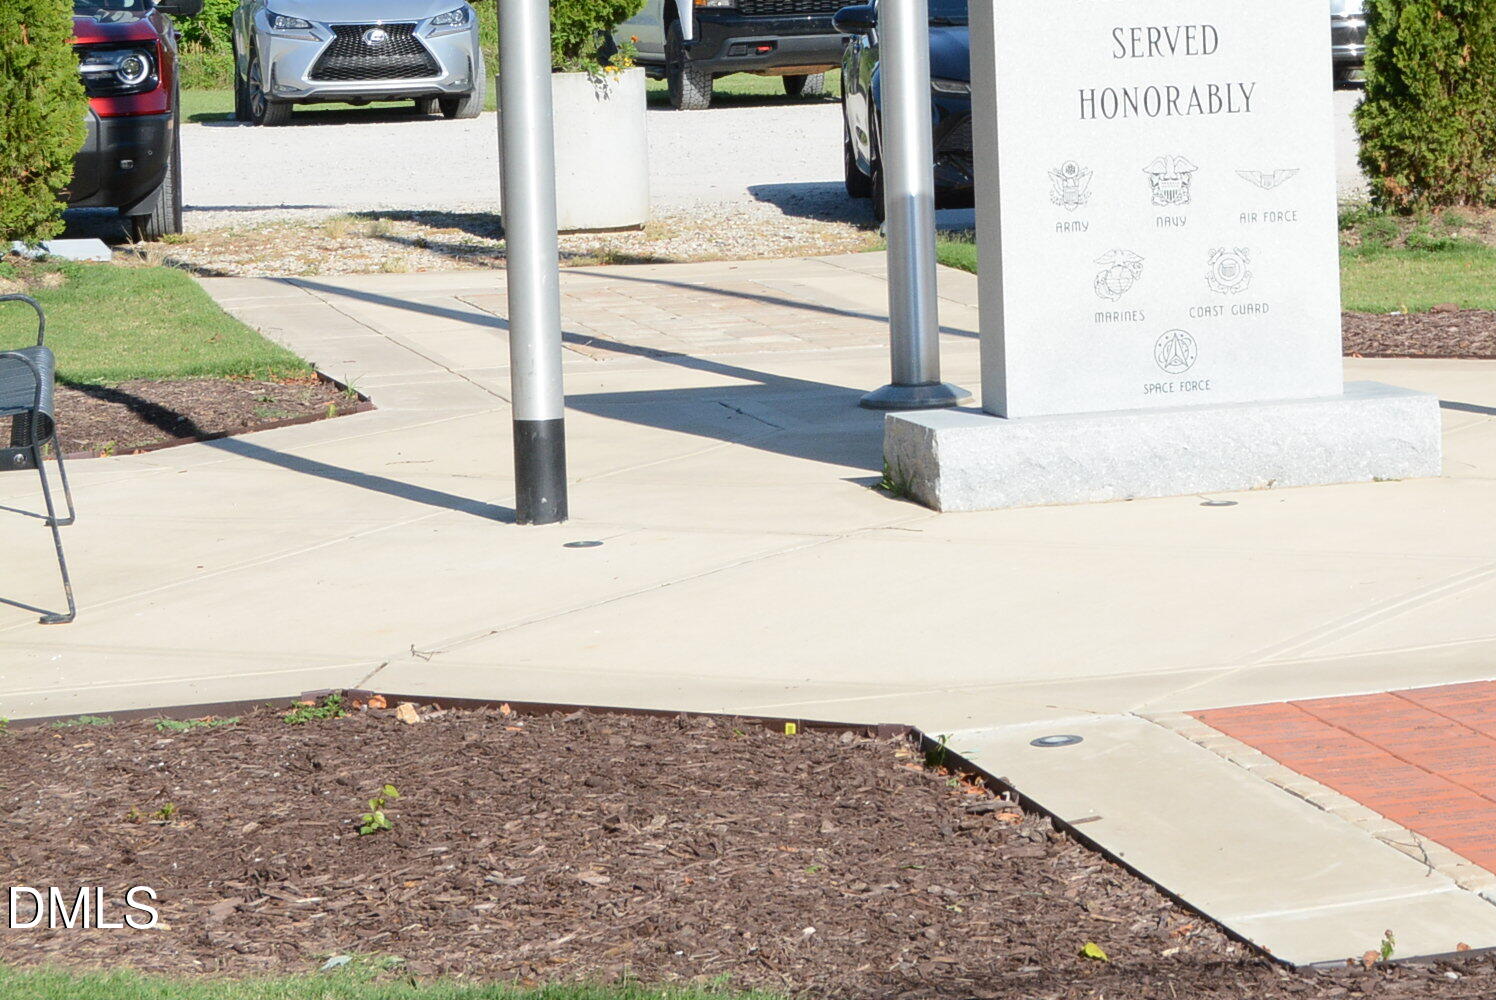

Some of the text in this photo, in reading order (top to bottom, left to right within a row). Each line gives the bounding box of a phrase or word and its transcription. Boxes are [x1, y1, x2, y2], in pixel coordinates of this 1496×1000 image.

[1112, 24, 1219, 60] SERVED
[1079, 81, 1256, 120] HONORABLY
[1156, 215, 1187, 228] NAVY
[1239, 210, 1298, 224] AIR FORCE
[1055, 220, 1089, 233] ARMY
[1094, 309, 1146, 324] MARINES
[1188, 302, 1270, 319] COAST GUARD
[1143, 379, 1211, 396] SPACE FORCE
